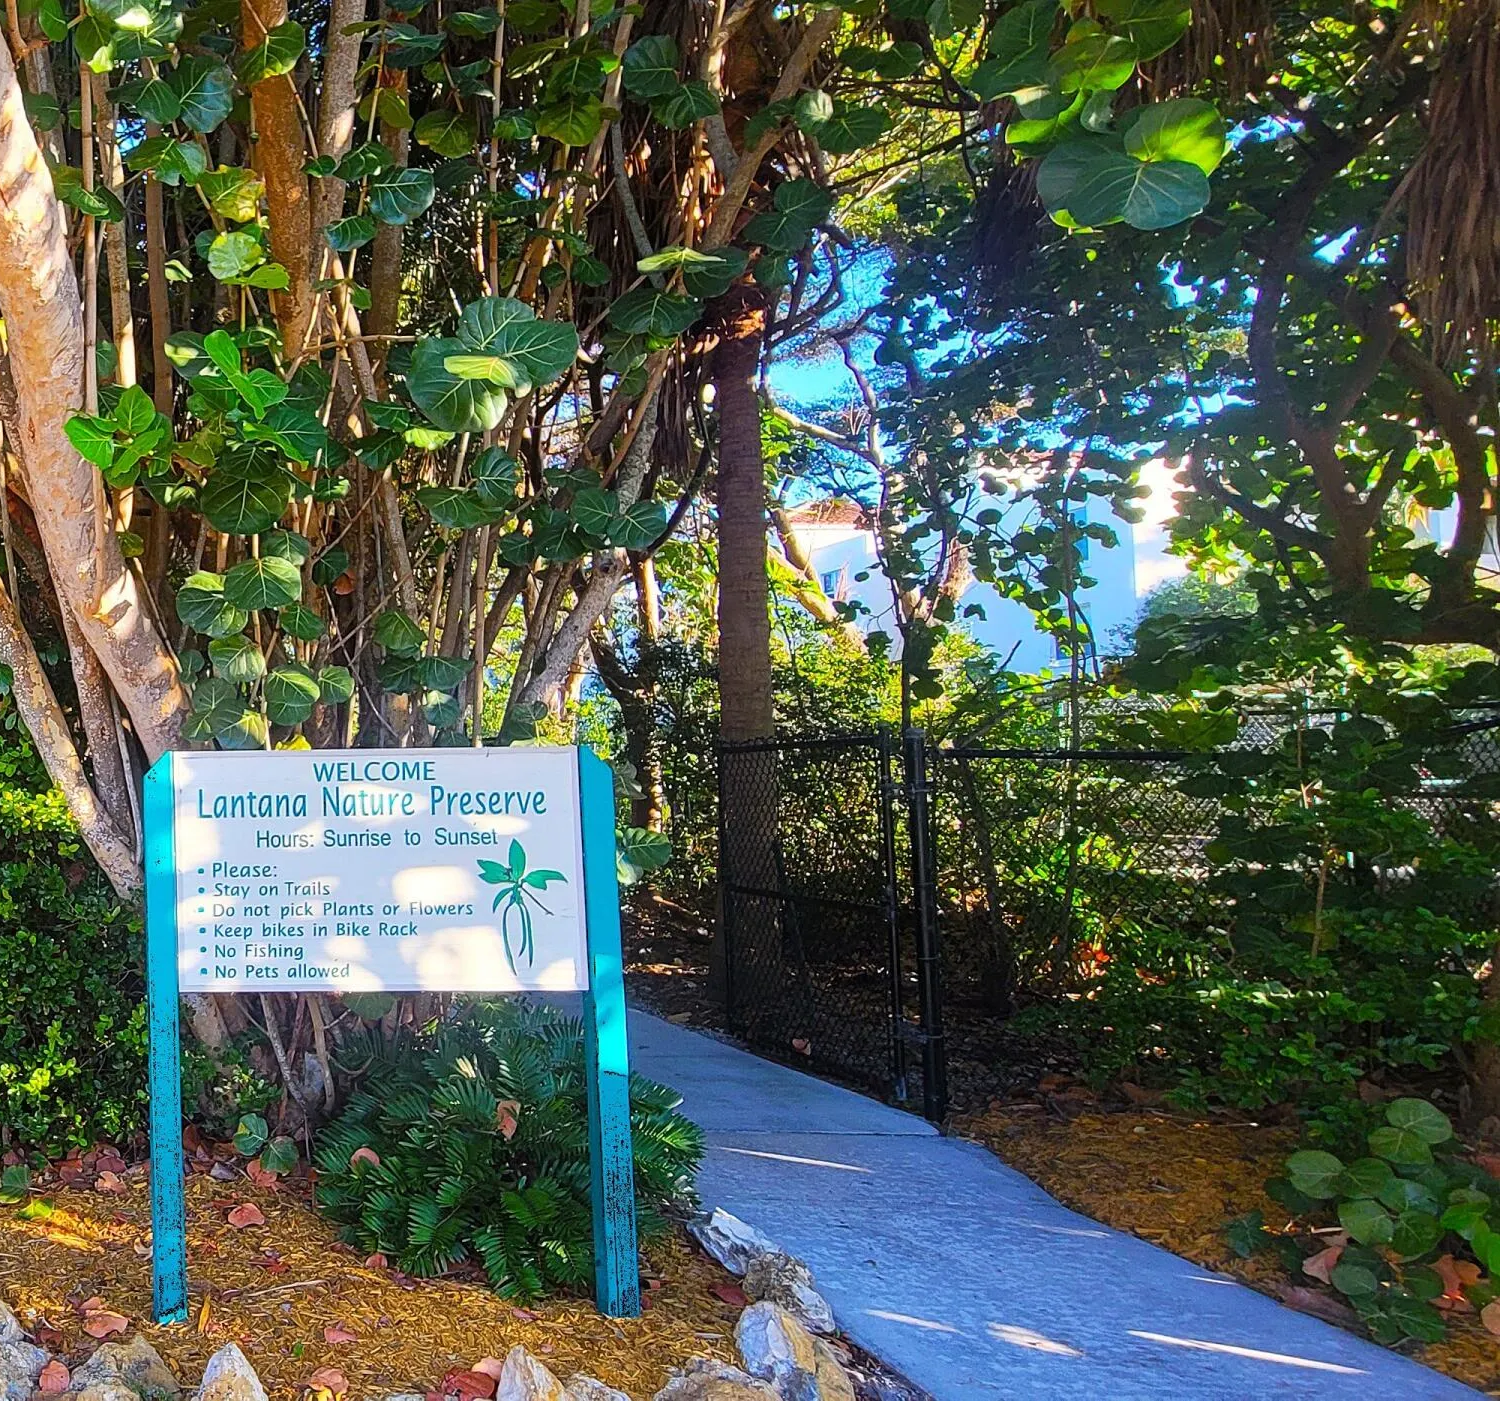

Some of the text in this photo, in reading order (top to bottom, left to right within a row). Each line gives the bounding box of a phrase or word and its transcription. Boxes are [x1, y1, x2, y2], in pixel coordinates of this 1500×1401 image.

[313, 761, 436, 782] WELCOME
[198, 785, 547, 819] Lantana Nature Preserve
[256, 828, 498, 849] Hours: Sunrise to Sunset
[212, 862, 278, 878] Please:
[213, 882, 330, 899] Stay on Trails
[213, 901, 473, 920] Do not pick Plants or Flowers
[214, 921, 418, 941] Keep bikes in Bike Rack
[215, 943, 303, 961] No Fishing
[215, 963, 350, 979] No Pets allowed
